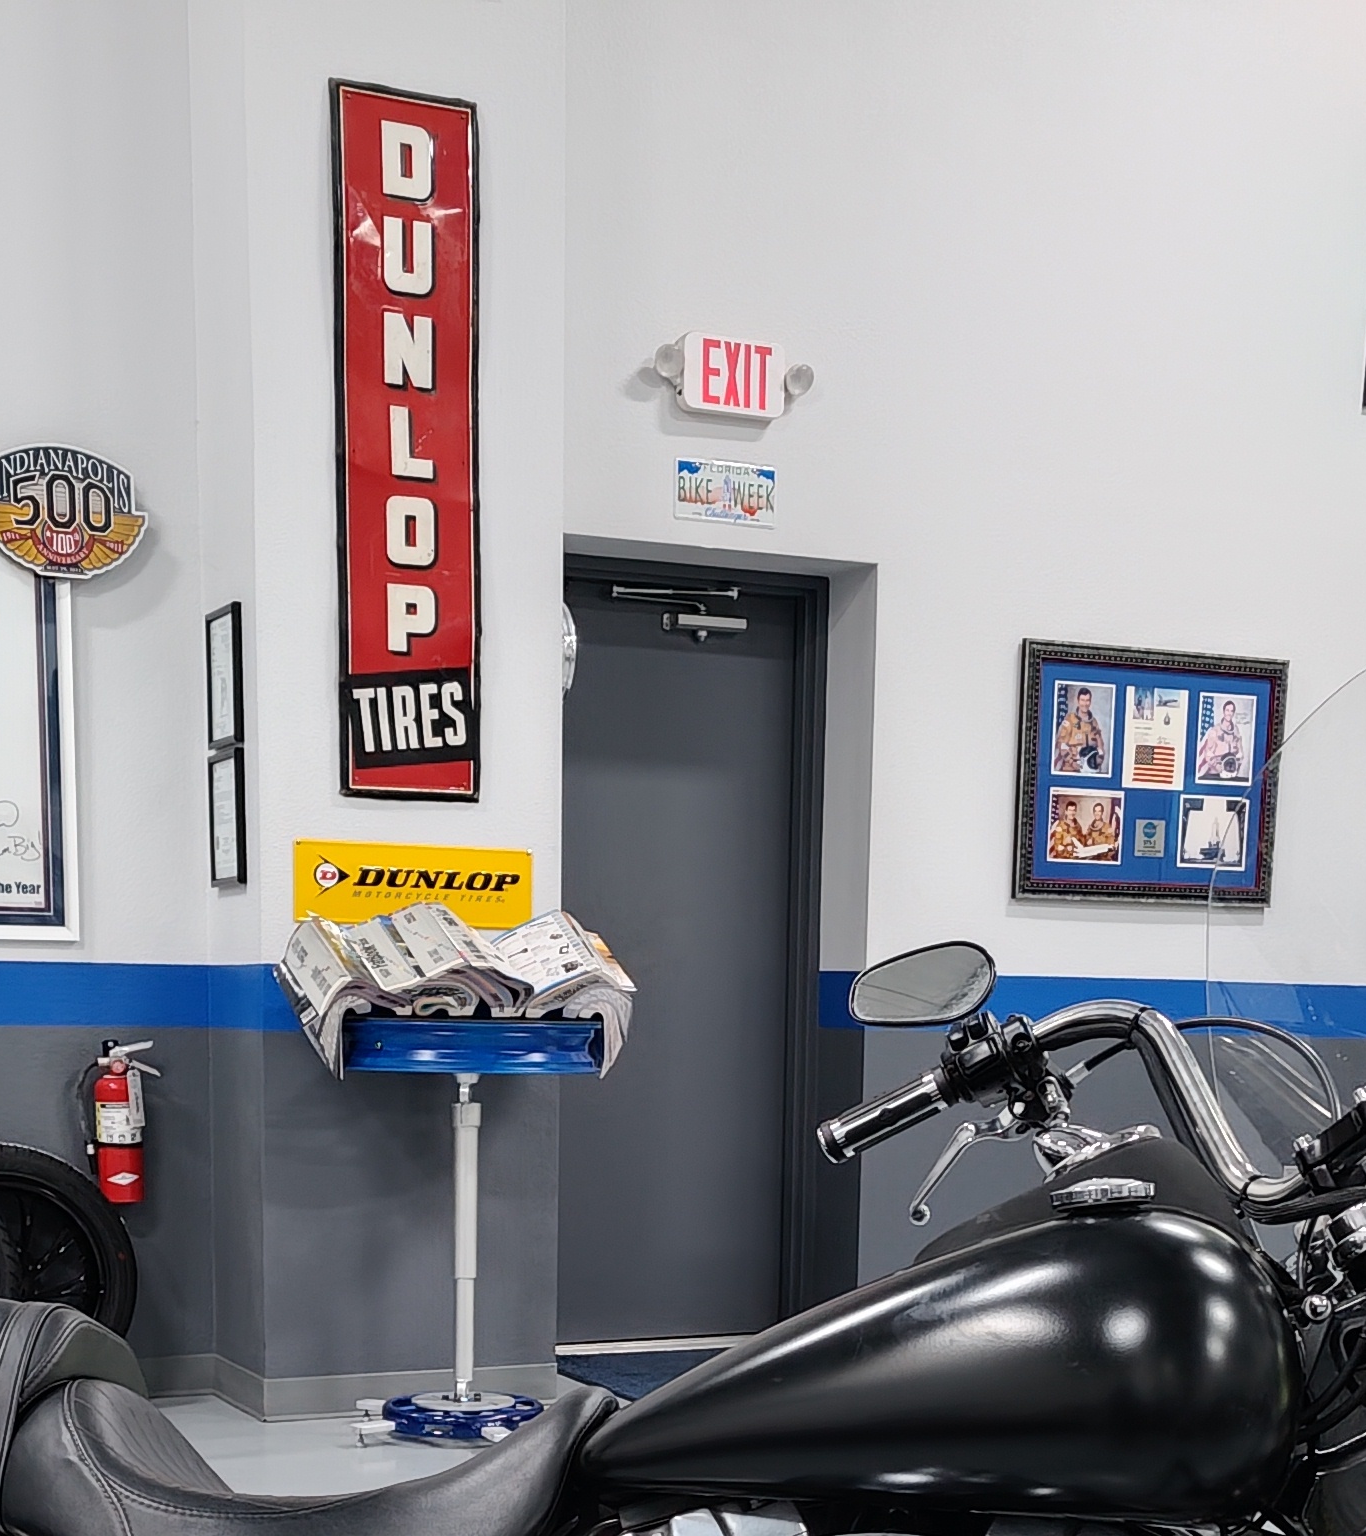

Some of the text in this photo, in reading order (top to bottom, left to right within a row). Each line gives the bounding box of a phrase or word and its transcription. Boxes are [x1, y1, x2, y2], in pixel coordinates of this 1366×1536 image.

[380, 119, 436, 653] DUNLOP
[702, 337, 773, 411] EXIT
[702, 463, 751, 477] FLORIDA
[10, 471, 114, 536] 500
[678, 475, 775, 514] BIKE WEEK
[36, 543, 89, 565] ANNIVERSARY
[352, 682, 466, 754] TIRES
[15, 881, 42, 895] Year
[353, 866, 521, 892] DUNLOP
[352, 889, 502, 904] MOTORCYCLE TIRES
